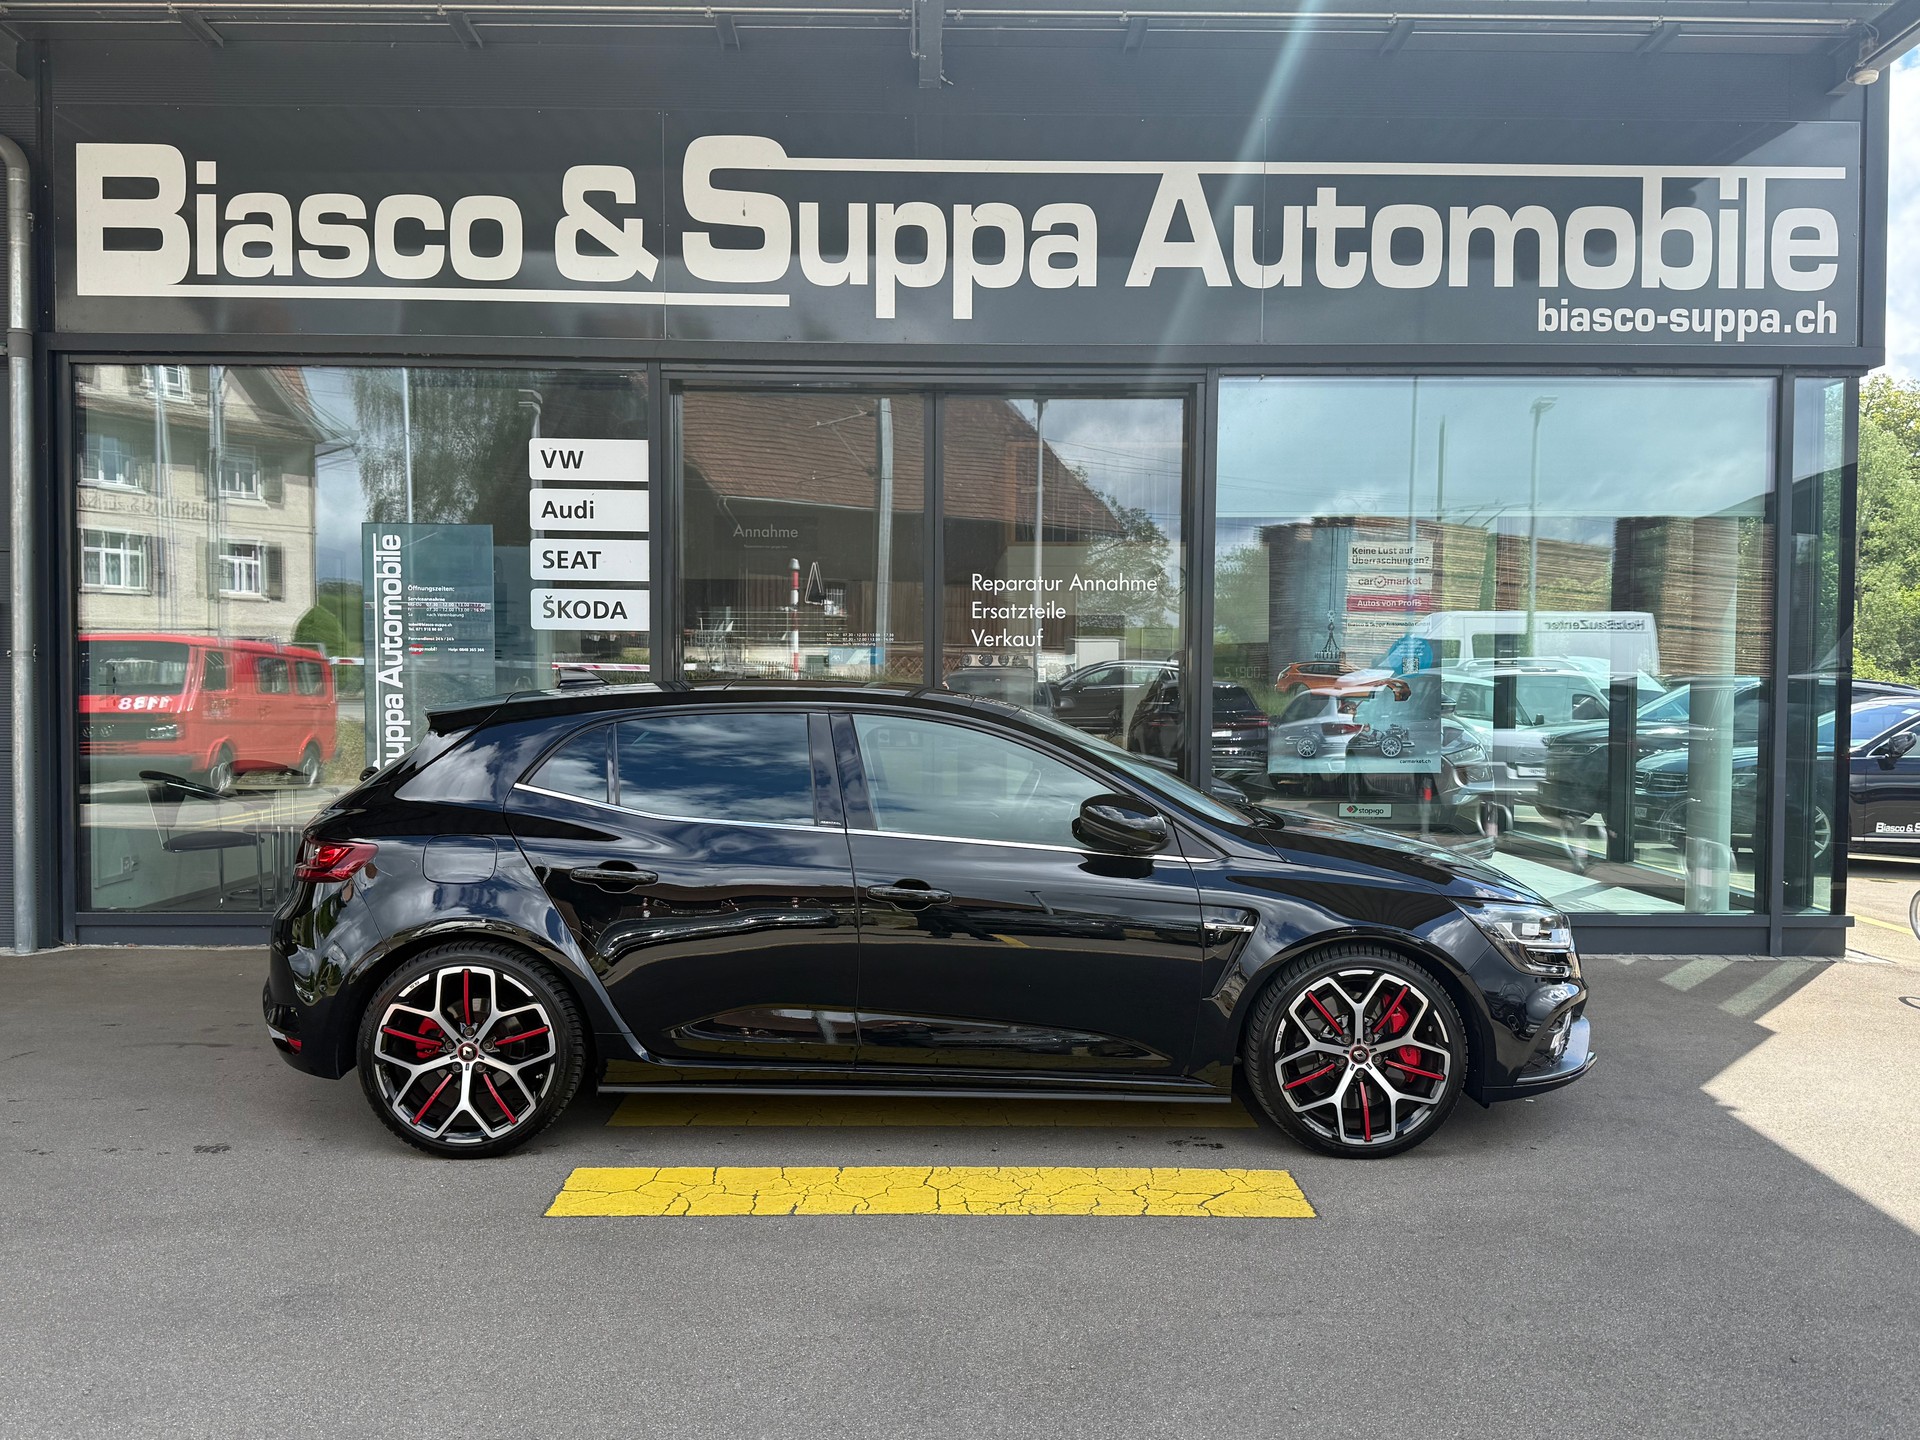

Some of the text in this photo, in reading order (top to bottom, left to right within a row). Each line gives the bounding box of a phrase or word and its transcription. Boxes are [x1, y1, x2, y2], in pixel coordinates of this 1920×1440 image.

[76, 135, 1839, 319] Biasco & Suppa Automobile
[1538, 298, 1837, 342] biasco-suppa.ch
[540, 449, 584, 469] VW
[541, 500, 595, 519] Audi
[732, 523, 799, 538] Annahme
[542, 550, 602, 569] SEAT
[1352, 546, 1414, 555] Keine Lust auf
[1352, 555, 1430, 565] Überraschungen?
[407, 584, 455, 593] Öffnungszeiten:
[971, 572, 1158, 596] Reparatur Annahme
[374, 533, 405, 689] Automobile
[543, 595, 628, 620] ŠKODA
[971, 600, 1067, 619] Ersatzteile
[1398, 599, 1422, 607] Profis
[971, 628, 1044, 647] Verkauf
[1875, 822, 1905, 832] Biasco
[1906, 824, 1913, 832] &
